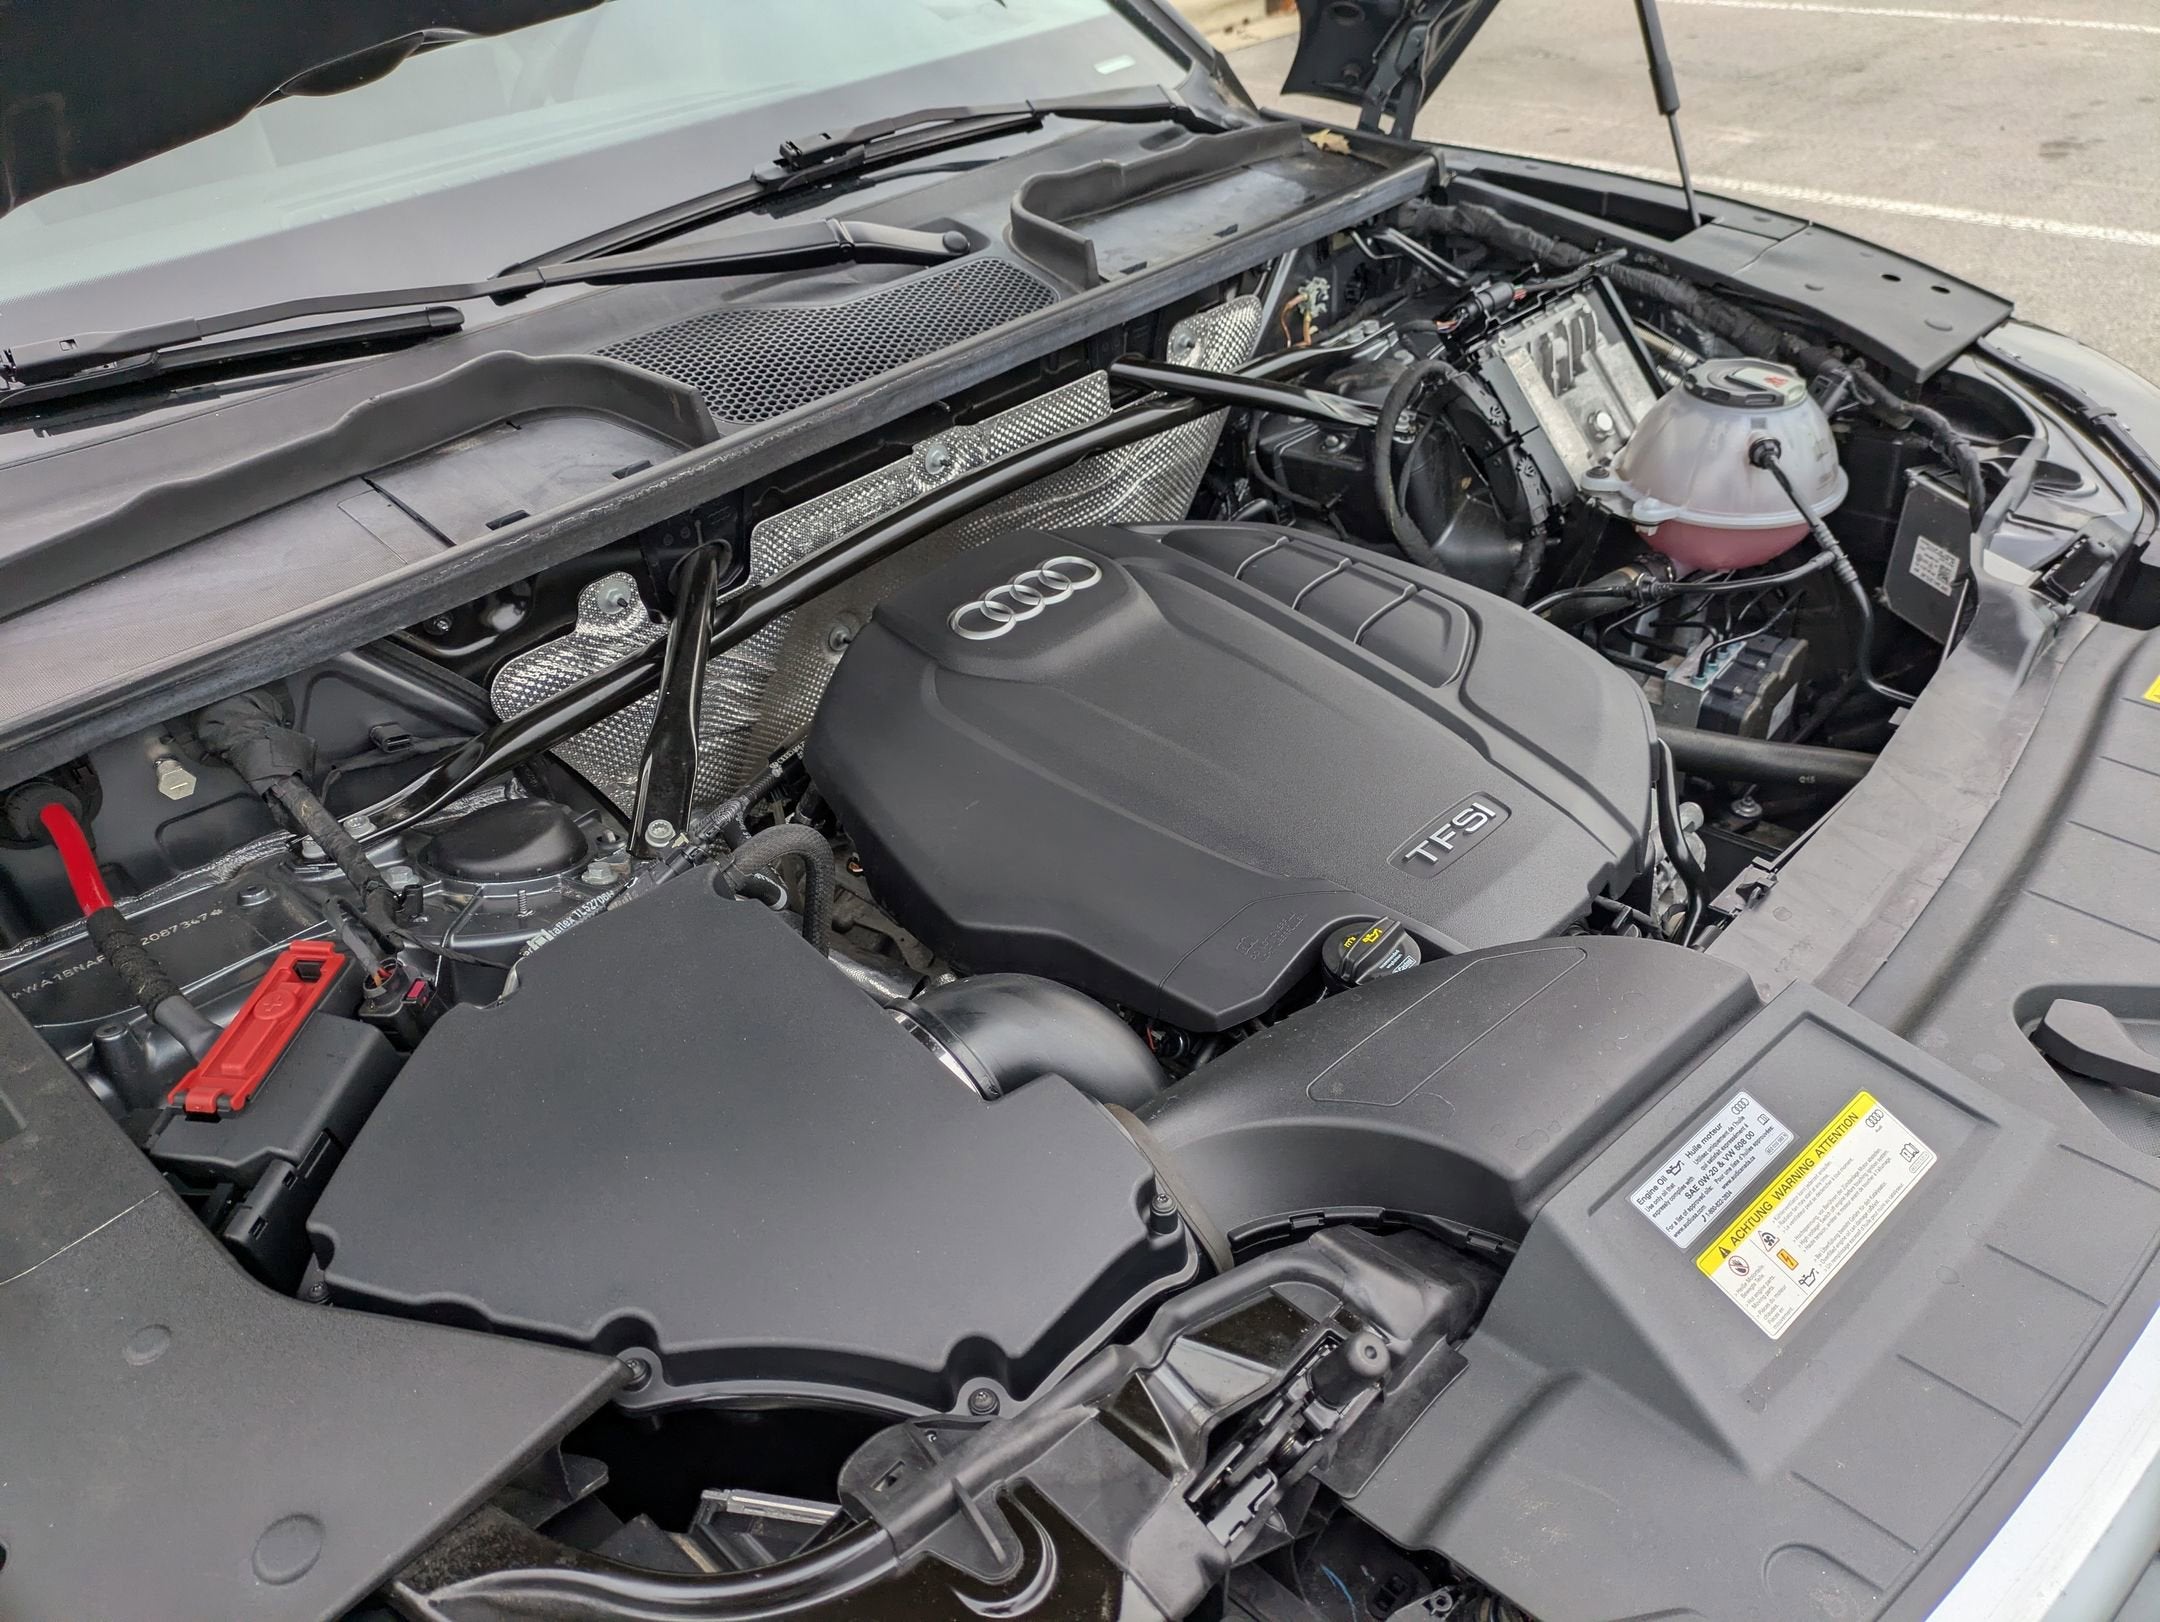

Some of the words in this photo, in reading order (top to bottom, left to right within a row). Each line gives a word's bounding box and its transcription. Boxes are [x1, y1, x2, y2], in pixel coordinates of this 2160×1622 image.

[1402, 801, 1497, 866] TFSI
[1684, 1141, 1702, 1159] Huile
[1699, 1122, 1723, 1144] moteur
[1683, 1175, 1694, 1185] with
[1684, 1184, 1700, 1199] SAE
[1697, 1165, 1718, 1186] 0W-20
[1716, 1159, 1725, 1167] &
[1722, 1148, 1736, 1161] VW
[1744, 1129, 1755, 1140] 00
[1728, 1200, 1774, 1247] ACHTUNG
[1771, 1156, 1815, 1202] WARNING
[1812, 1110, 1859, 1159] ATTENTION
[1636, 1183, 1659, 1206] Engine
[1656, 1174, 1668, 1186] Oil
[1645, 1203, 1654, 1212] Use
[1652, 1194, 1663, 1205] only
